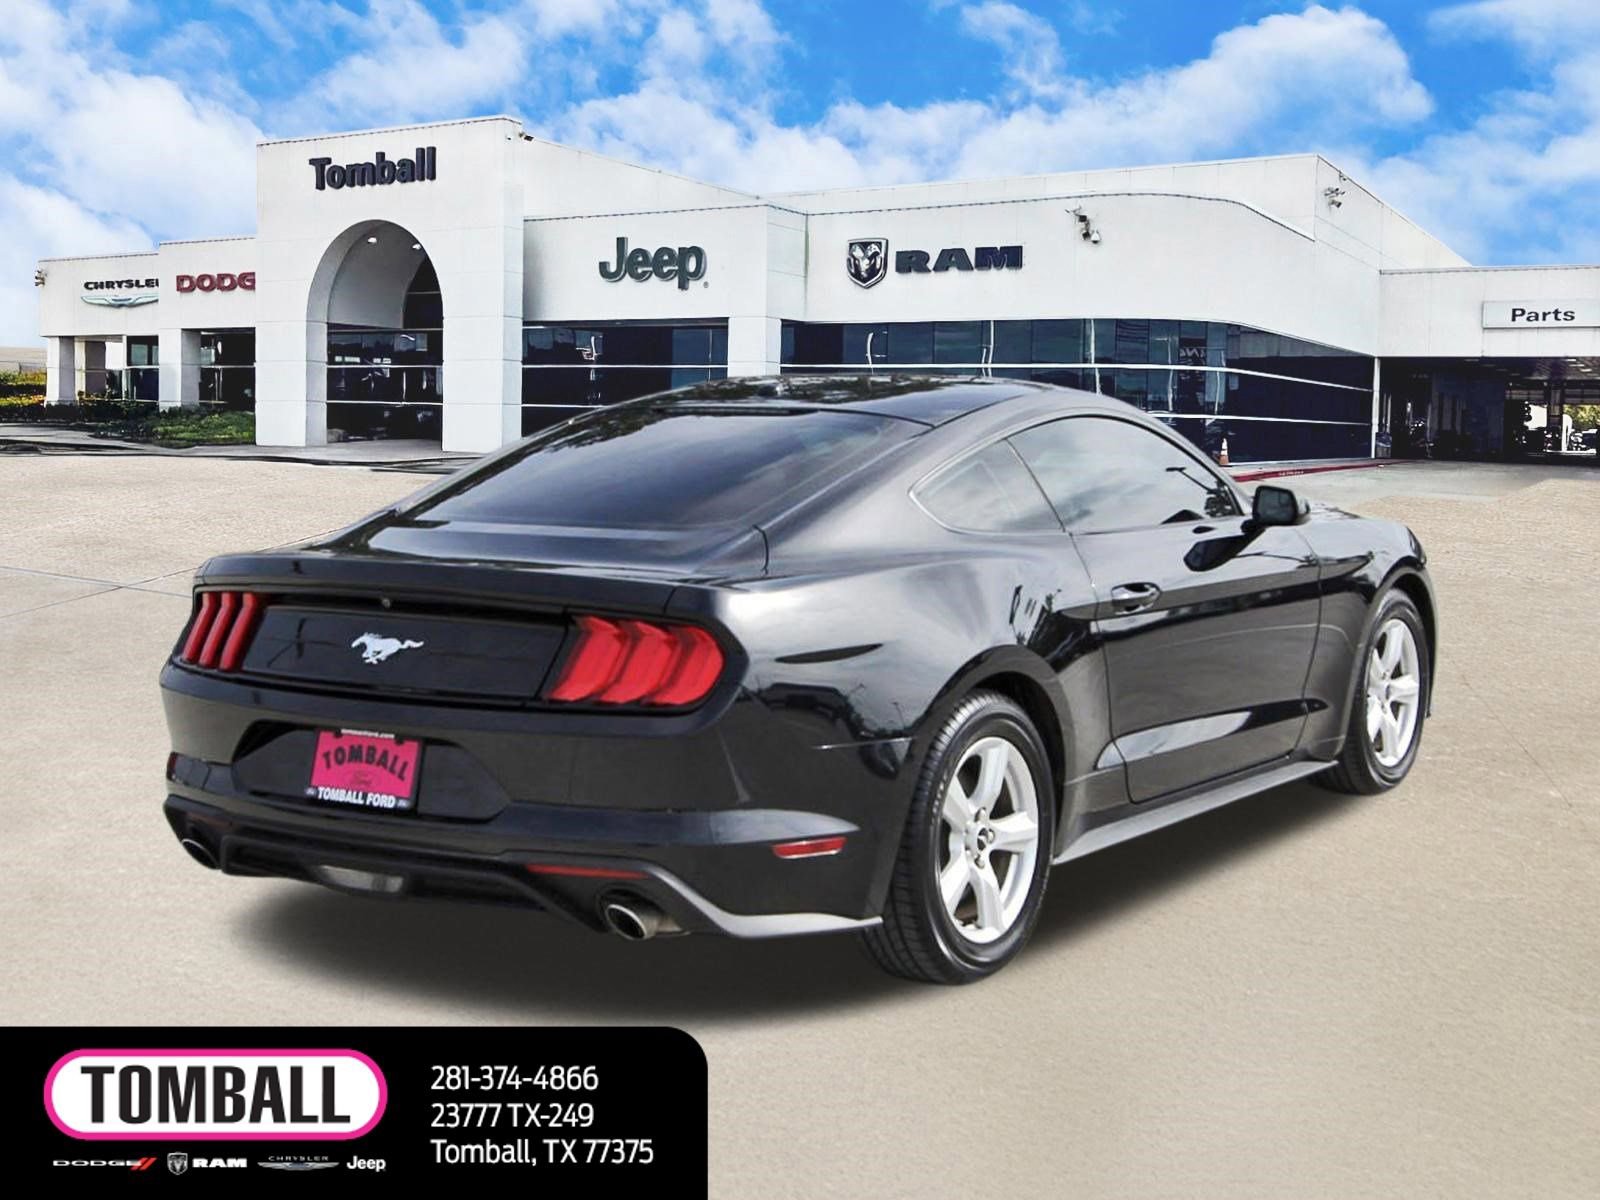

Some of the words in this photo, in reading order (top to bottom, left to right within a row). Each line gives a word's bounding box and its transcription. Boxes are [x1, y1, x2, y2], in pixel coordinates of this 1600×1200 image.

[309, 146, 437, 191] Tomball
[598, 236, 706, 291] Jeep
[895, 245, 1024, 275] RAM
[1510, 308, 1576, 323] Parts
[323, 744, 408, 781] TOMBALL
[318, 787, 364, 804] TOMBALL
[366, 793, 396, 808] FORD
